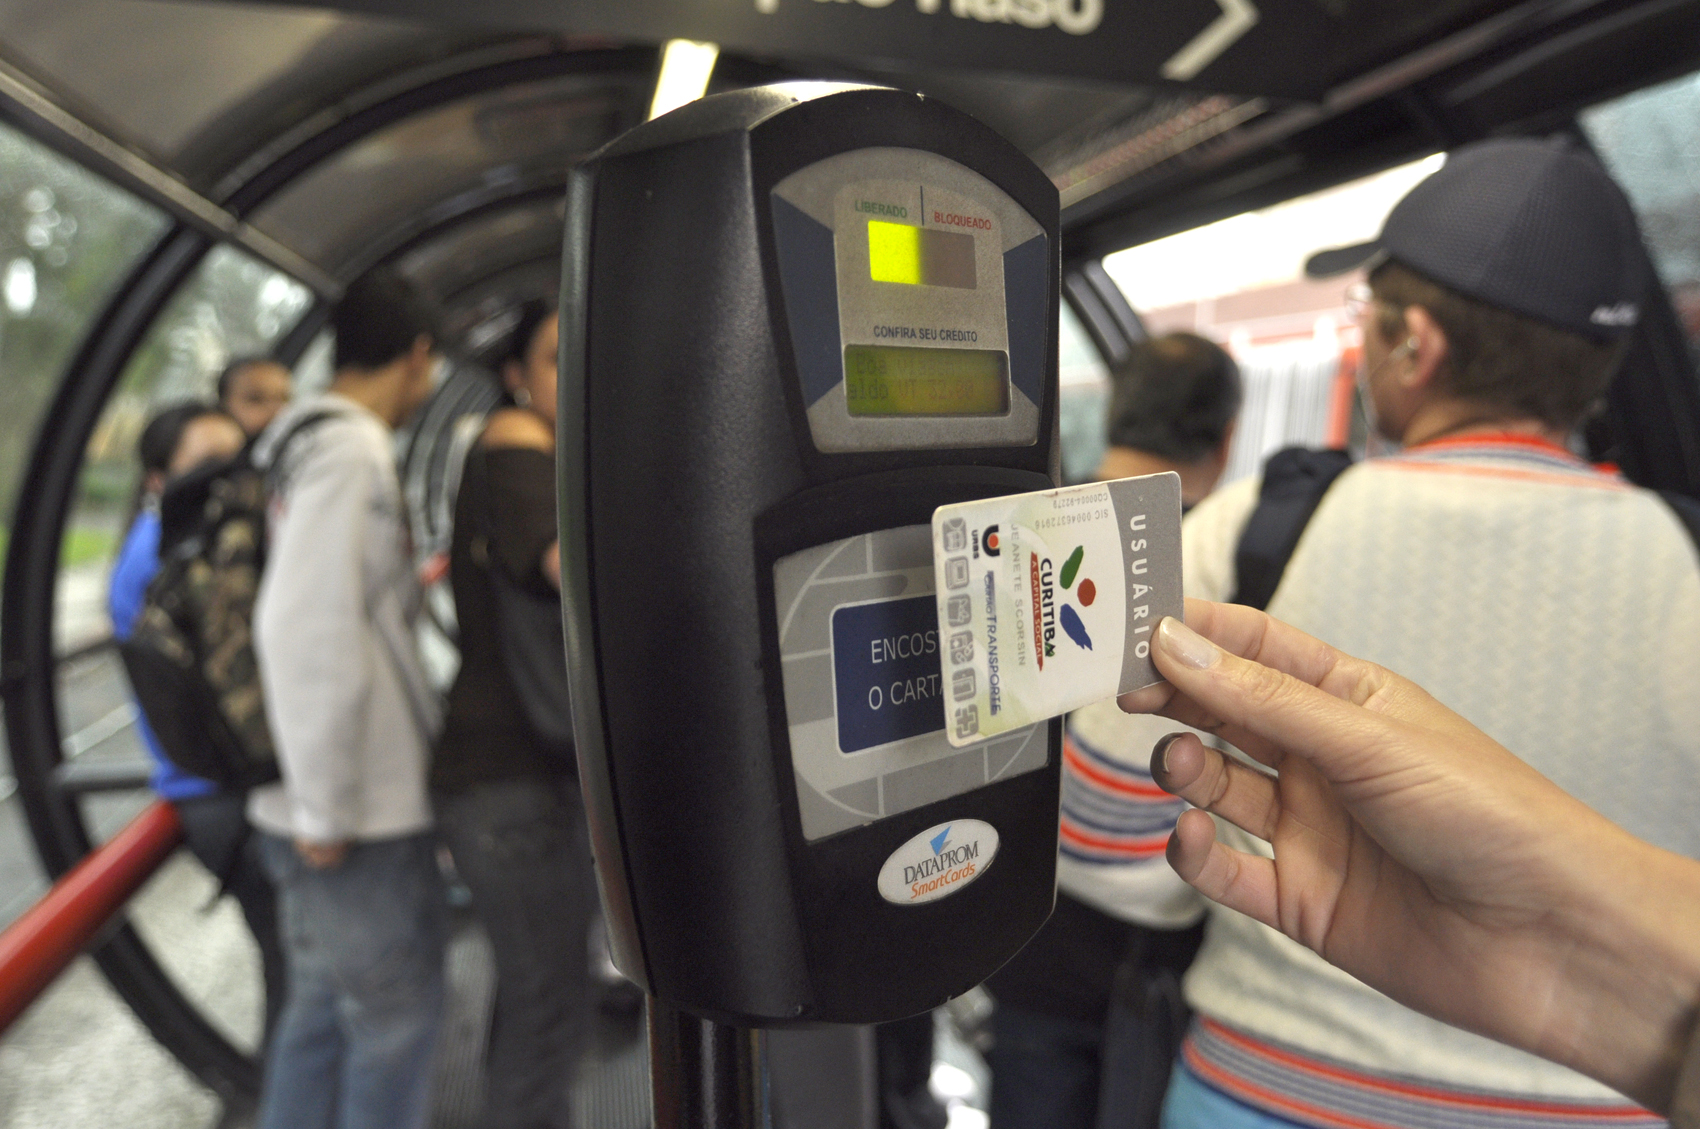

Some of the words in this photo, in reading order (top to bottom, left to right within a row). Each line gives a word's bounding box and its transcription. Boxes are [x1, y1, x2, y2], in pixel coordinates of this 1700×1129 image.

[854, 200, 908, 219] LIBERADO
[934, 211, 992, 231] BLOQUEADO
[873, 325, 917, 339] CONFIRA
[919, 328, 938, 341] SEU
[1094, 508, 1109, 520] SIC
[970, 529, 980, 560] URBS
[1011, 523, 1023, 593] JEANETE
[1032, 570, 1041, 619] CAPITAL
[1130, 514, 1153, 659] USUÁRIO
[1040, 558, 1056, 658] CURITIBA
[871, 630, 940, 664] ENCOS
[1014, 599, 1026, 666] SCORSIN
[1034, 619, 1043, 659] SOCIAL
[986, 614, 1002, 712] TRANSPORTE
[868, 685, 883, 710] O
[904, 840, 979, 885] DATAPROM
[911, 861, 976, 899] SmartCards
